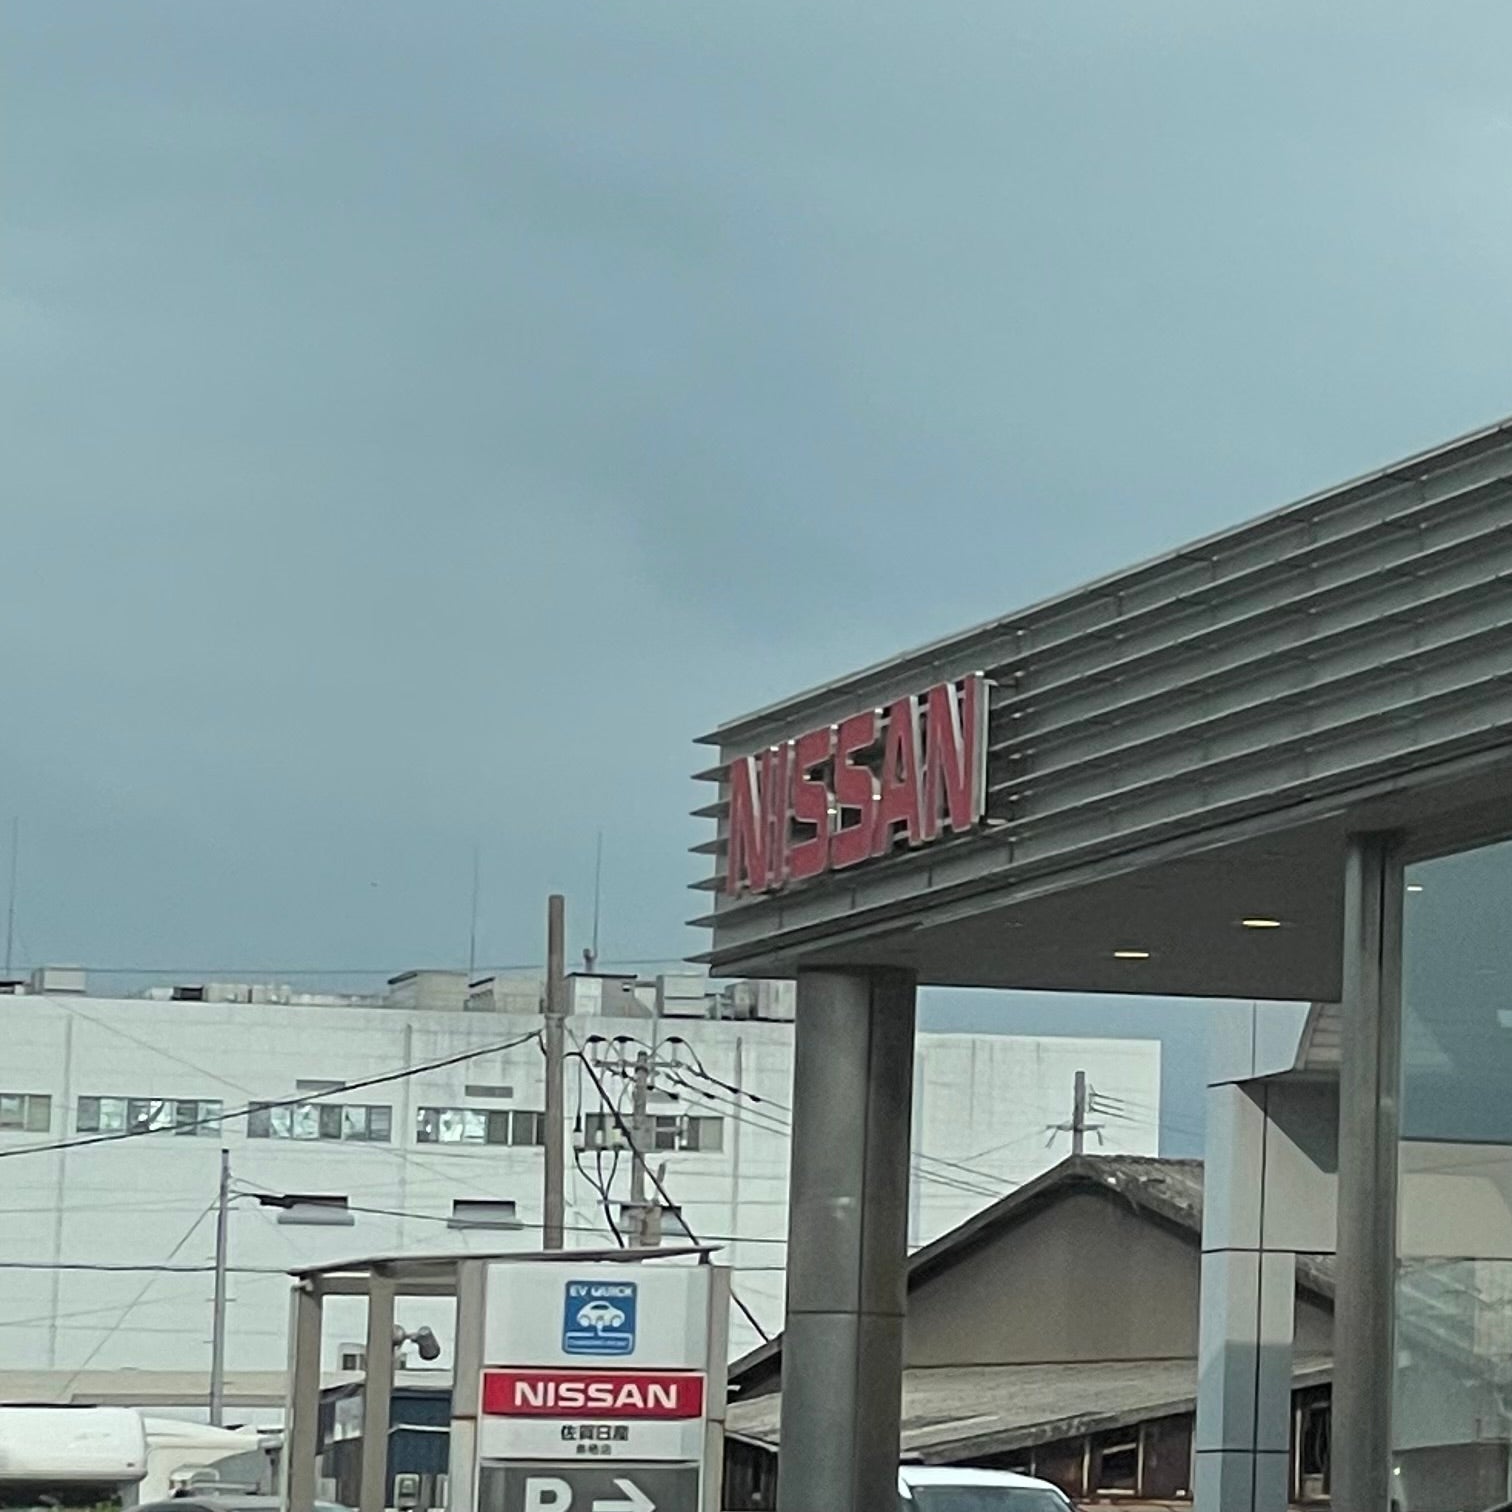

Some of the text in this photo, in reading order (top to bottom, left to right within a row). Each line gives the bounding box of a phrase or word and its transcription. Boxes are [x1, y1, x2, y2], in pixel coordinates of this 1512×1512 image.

[726, 672, 980, 897] NISSAN
[569, 1285, 588, 1297] EV
[514, 1381, 677, 1409] NISSAN
[526, 1477, 572, 1512] P
